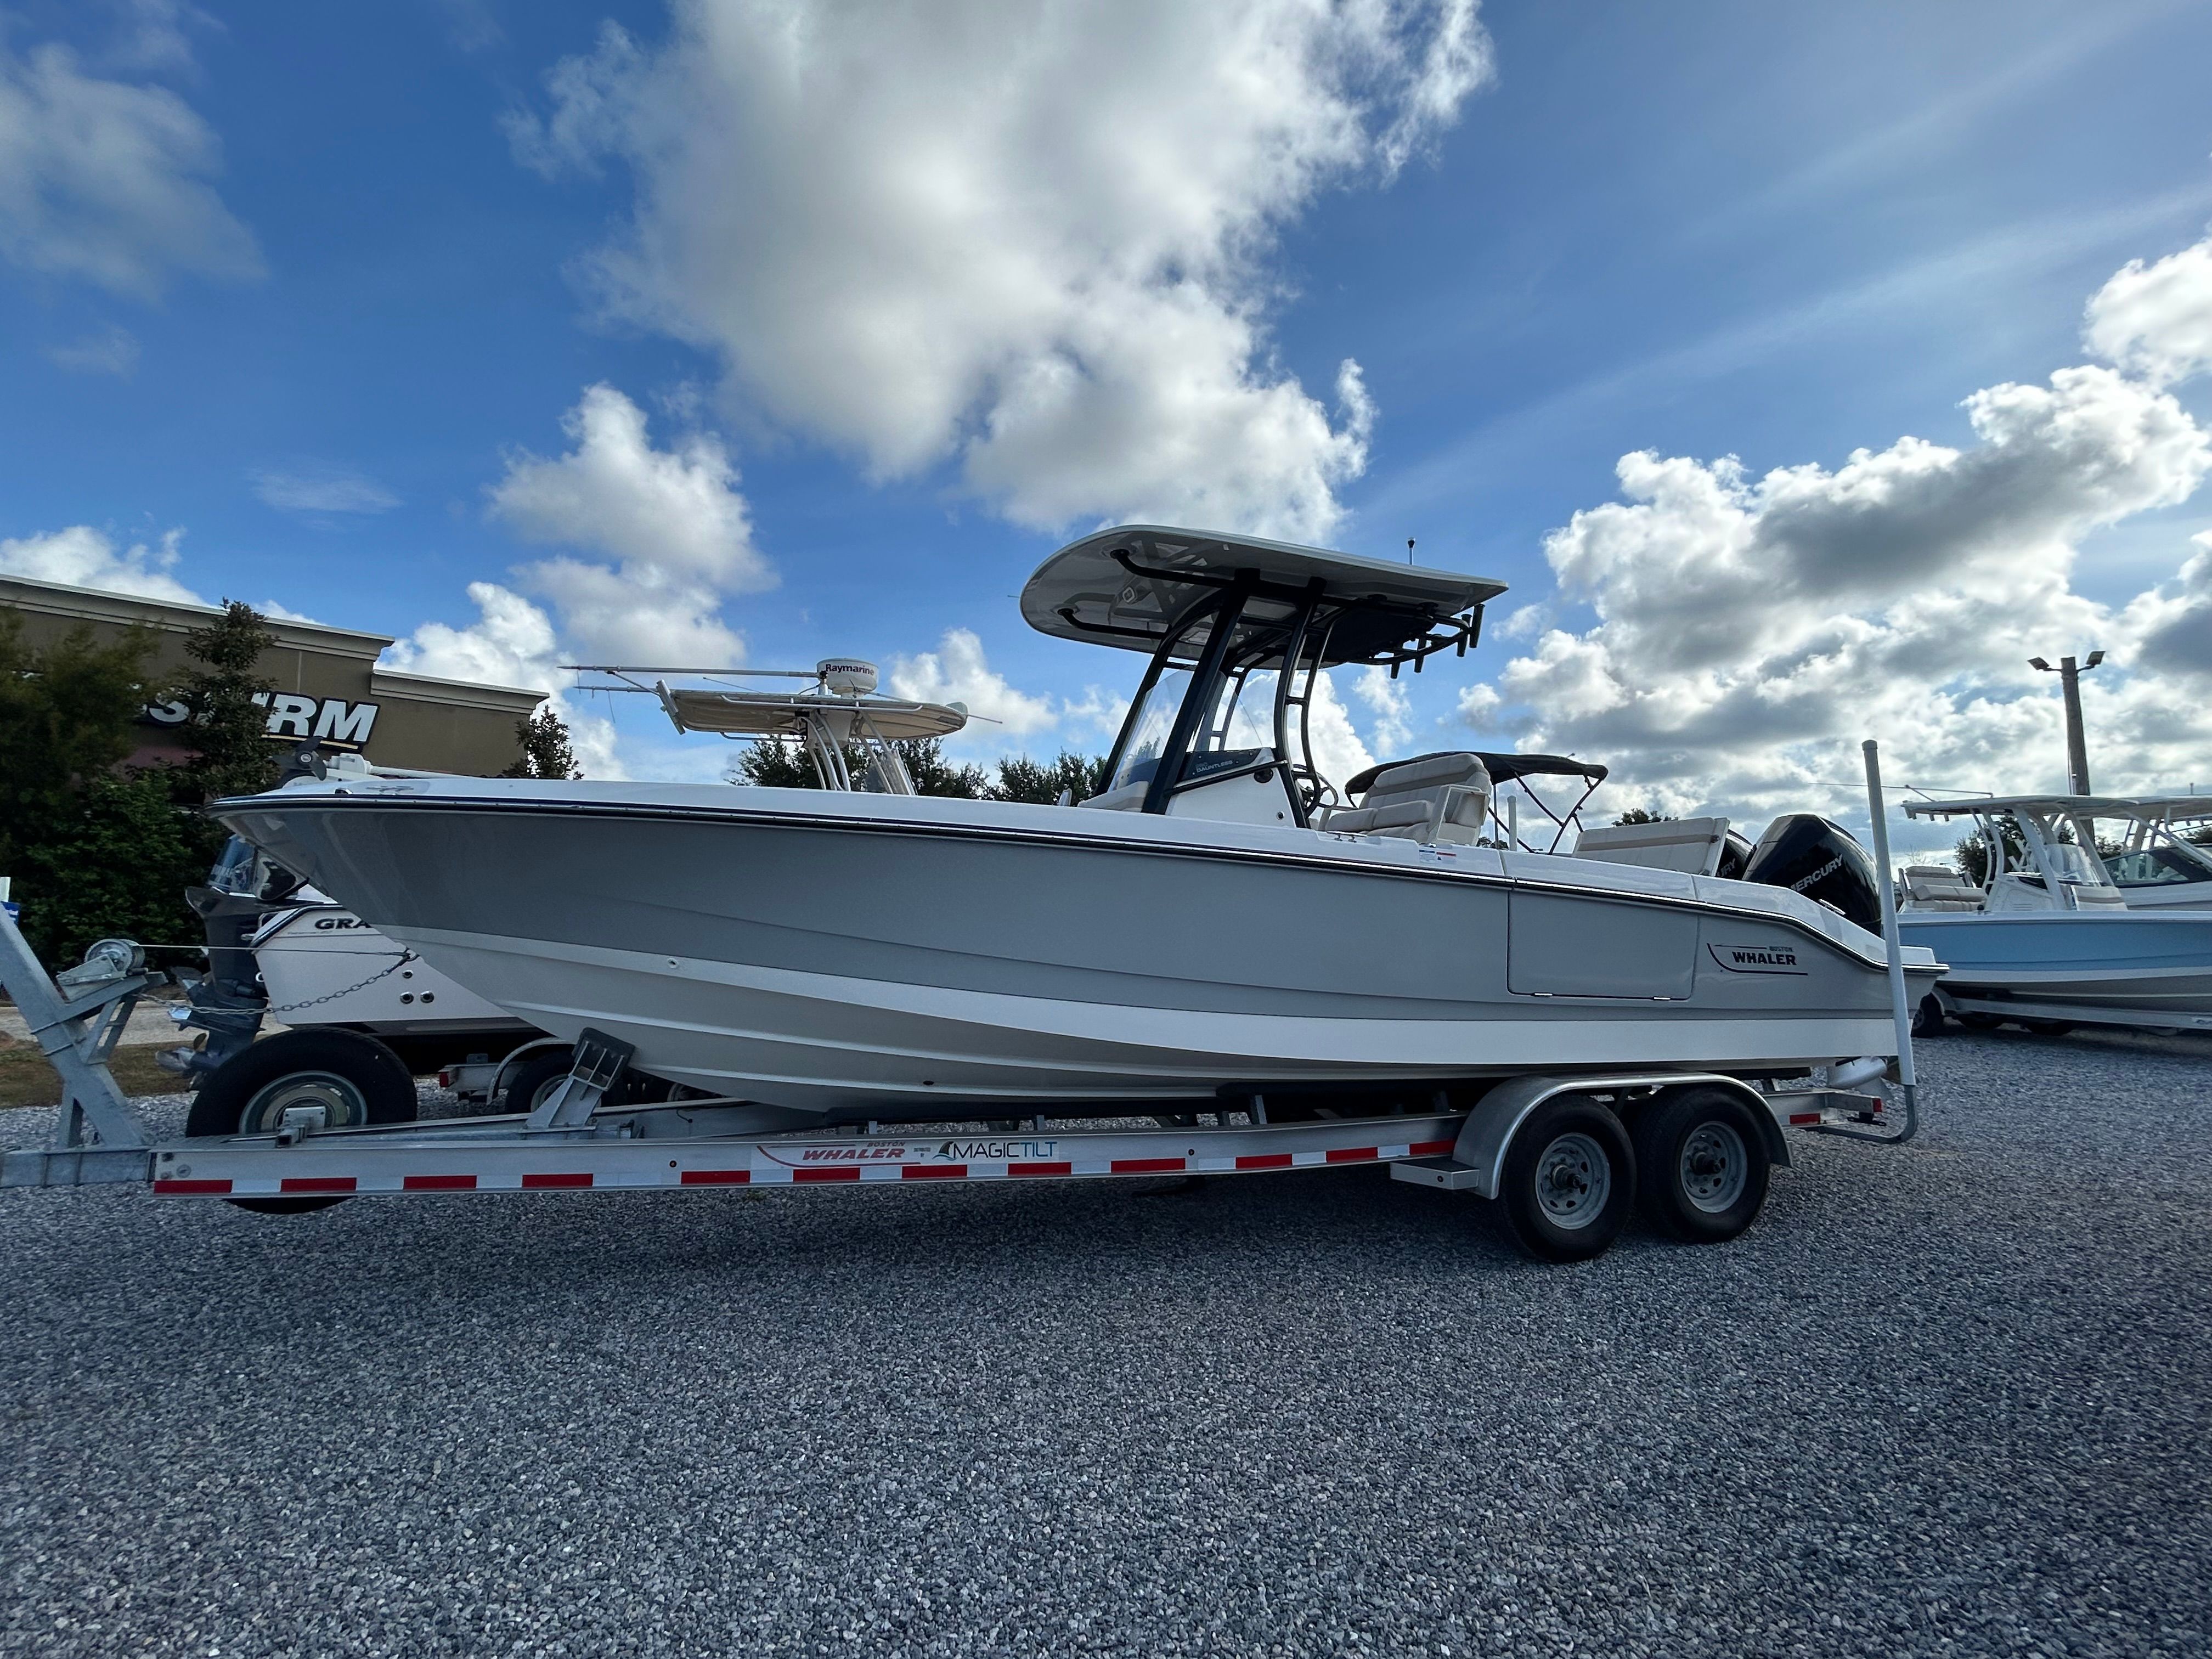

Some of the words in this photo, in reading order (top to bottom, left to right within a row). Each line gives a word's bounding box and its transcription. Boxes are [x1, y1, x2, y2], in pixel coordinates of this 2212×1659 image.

[826, 664, 874, 676] Raymarine
[1196, 760, 1233, 773] DAUNTLESS
[1732, 952, 1797, 966] WHALER
[803, 1148, 905, 1160] WHALER
[953, 1141, 1058, 1159] MAGICTILT
